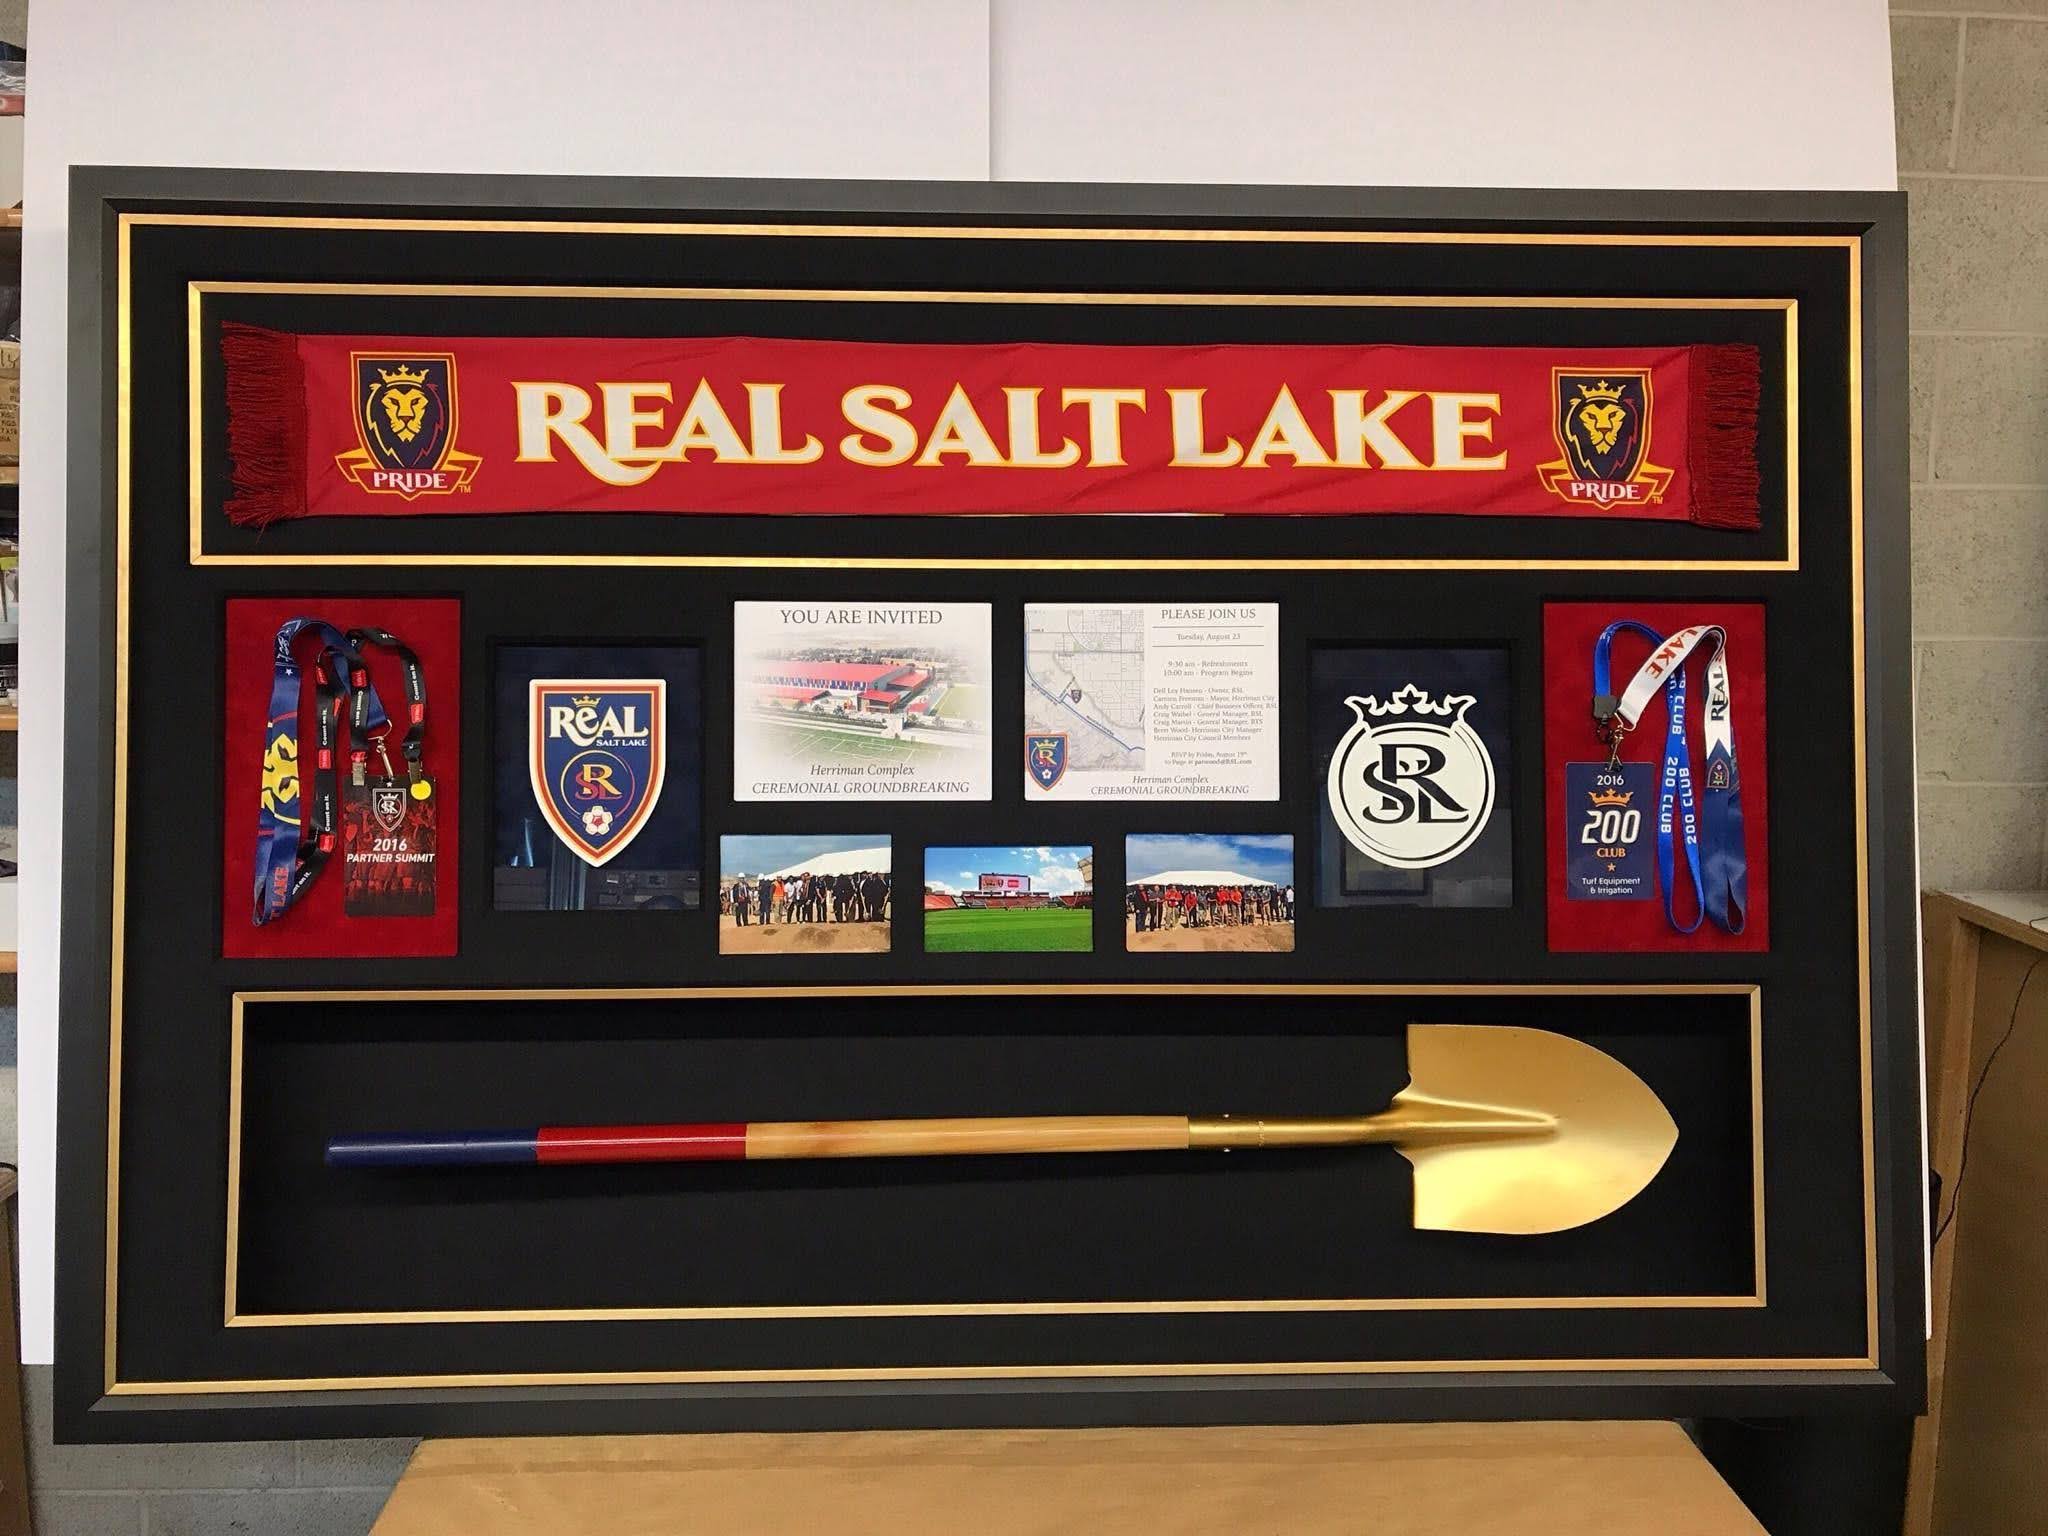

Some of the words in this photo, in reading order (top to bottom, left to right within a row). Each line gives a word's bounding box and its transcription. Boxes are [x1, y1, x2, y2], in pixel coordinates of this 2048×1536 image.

[510, 376, 824, 486] REAL
[839, 381, 1147, 468] SALT
[1164, 382, 1508, 471] LAKE
[373, 471, 448, 493] PRIDE
[1570, 482, 1641, 503] PRIDE
[780, 609, 819, 625] YOU
[826, 609, 863, 625] ARE
[868, 609, 943, 625] INVITED
[1160, 608, 1206, 619] PLEASE
[1207, 609, 1236, 620] JOIN
[1240, 608, 1257, 619] US
[1645, 628, 1698, 680] LAKE
[1710, 666, 1729, 721] REAL
[1671, 695, 1685, 735] CLUB
[596, 739, 621, 747] SALT
[622, 738, 648, 747] LAKE
[810, 763, 865, 777] Herriman
[867, 762, 916, 779] Complex
[1665, 756, 1679, 788] 200
[752, 782, 841, 795] CEREMONIAL
[843, 781, 970, 794] GROUNDBREAKING
[1132, 774, 1172, 784] Herriman
[1173, 774, 1210, 786] Complex
[1596, 774, 1625, 786] 2016
[1679, 767, 1693, 807] CLUB
[1090, 785, 1156, 796] CEREMONIAL
[1156, 784, 1250, 795] GROUNDBREAKING
[1661, 794, 1674, 833] CLUB
[1581, 809, 1642, 844] 200
[1684, 813, 1697, 845] 200
[372, 837, 408, 852] 2016
[1596, 847, 1626, 858] CLUB
[346, 852, 393, 863] PARTNER
[394, 853, 436, 863] SUMMIT
[1581, 877, 1597, 886] Turf
[1598, 877, 1641, 888] Equipment
[1597, 886, 1633, 896] Irrigation
